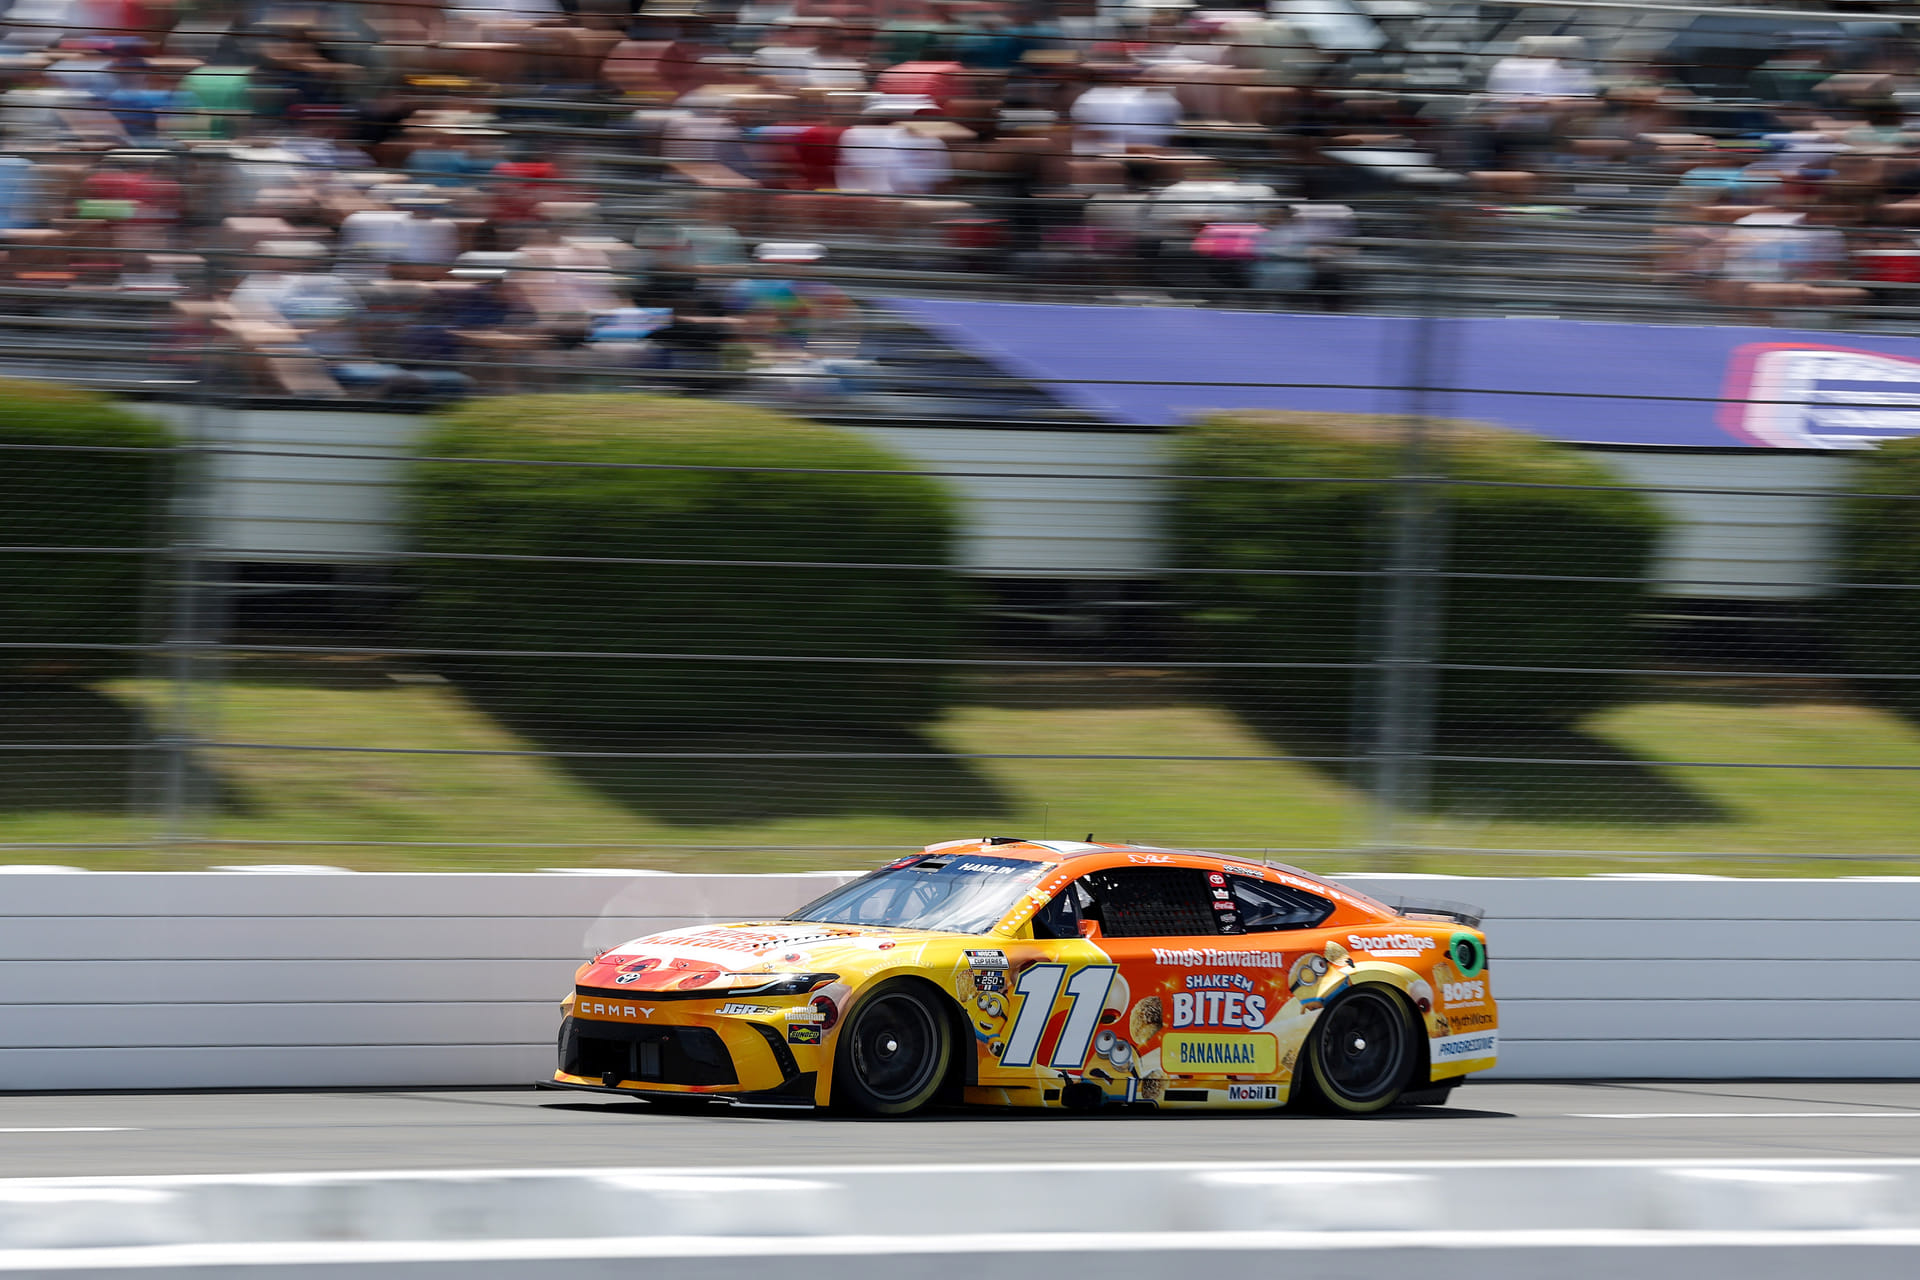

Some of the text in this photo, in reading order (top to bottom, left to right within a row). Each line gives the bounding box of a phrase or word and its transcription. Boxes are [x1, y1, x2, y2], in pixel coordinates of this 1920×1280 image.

[957, 863, 1017, 874] HAMLIN
[1152, 948, 1284, 968] King's Hawaiian
[981, 976, 999, 985] 250
[1443, 980, 1485, 1002] BOB'S
[581, 1002, 656, 1018] CAMRY
[997, 962, 1120, 1069] 11
[1172, 991, 1266, 1029] BITES
[790, 1031, 820, 1039] SUNOCO
[1180, 1042, 1255, 1064] BANANAAA!
[1229, 1086, 1277, 1100] Mobil 1
